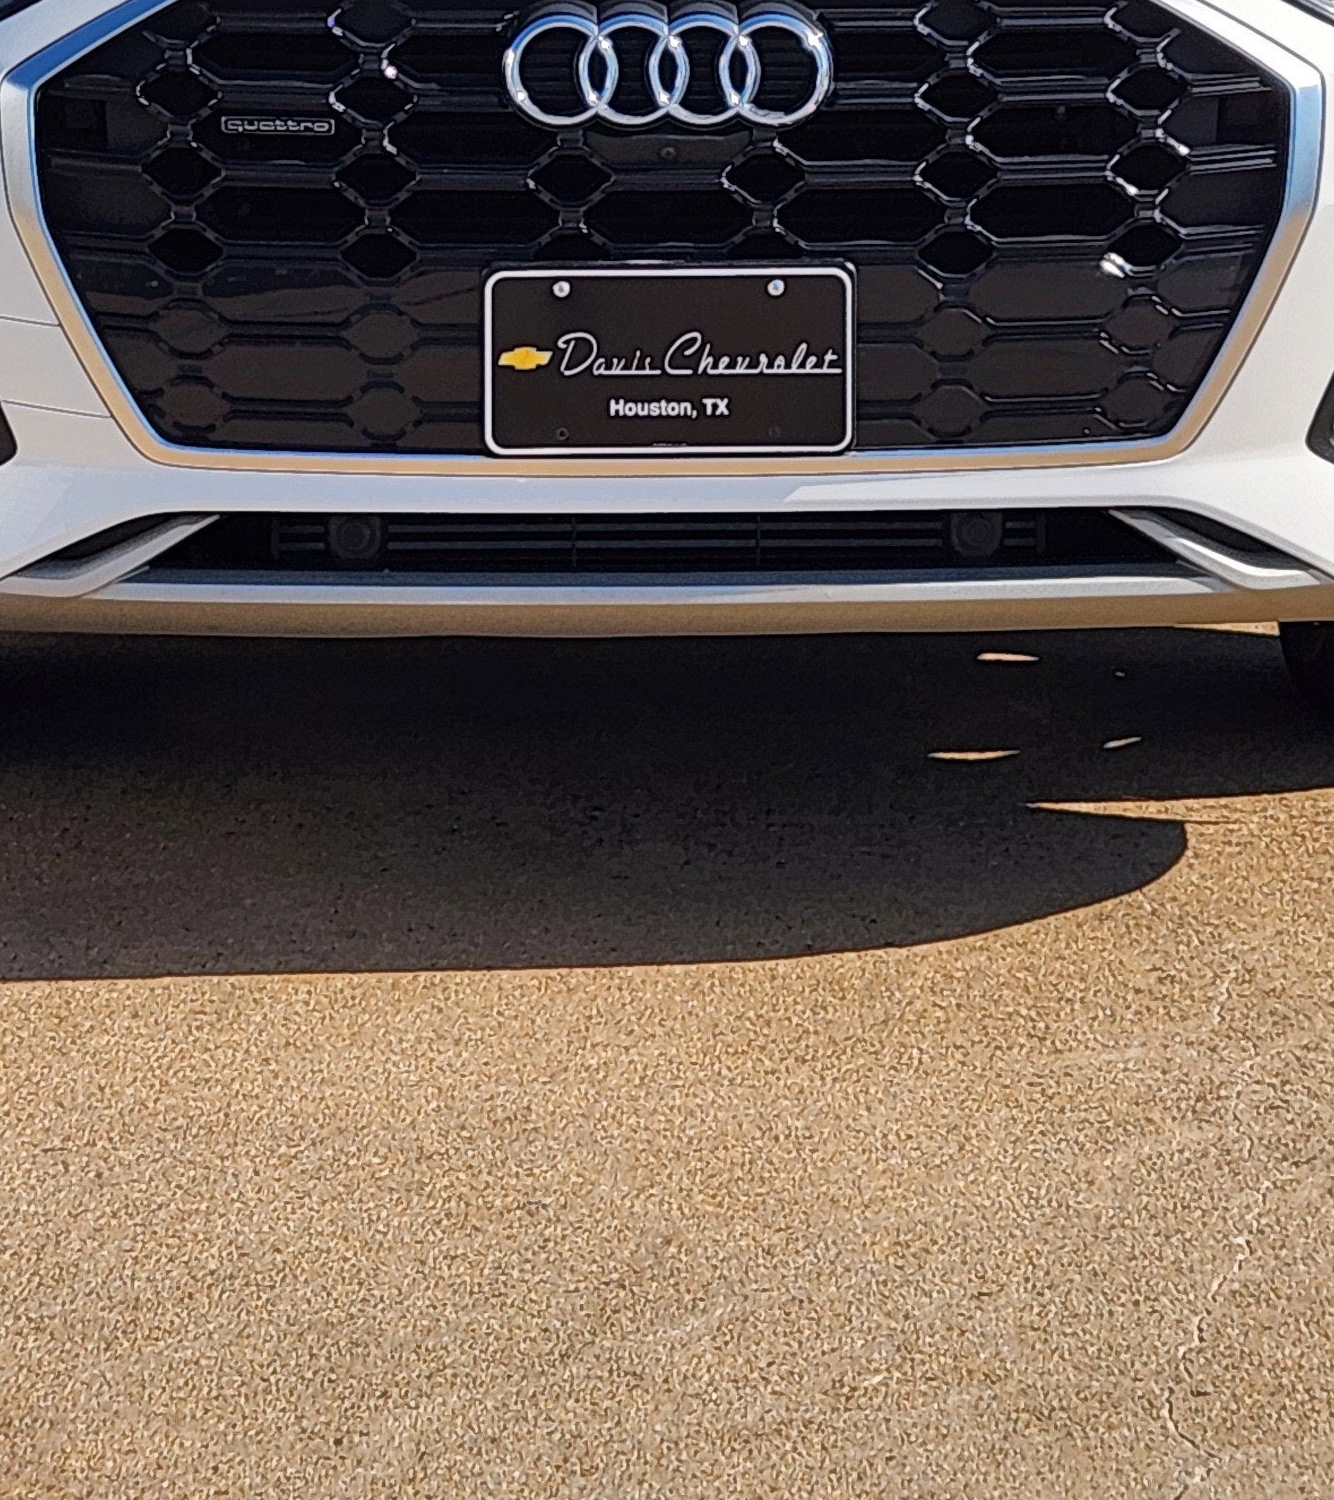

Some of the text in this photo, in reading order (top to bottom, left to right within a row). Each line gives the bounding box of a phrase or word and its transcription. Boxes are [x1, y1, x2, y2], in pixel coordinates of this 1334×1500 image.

[227, 119, 329, 132] quattro
[557, 331, 843, 376] Davis Chevrolet
[609, 397, 730, 420] Houston, TX
